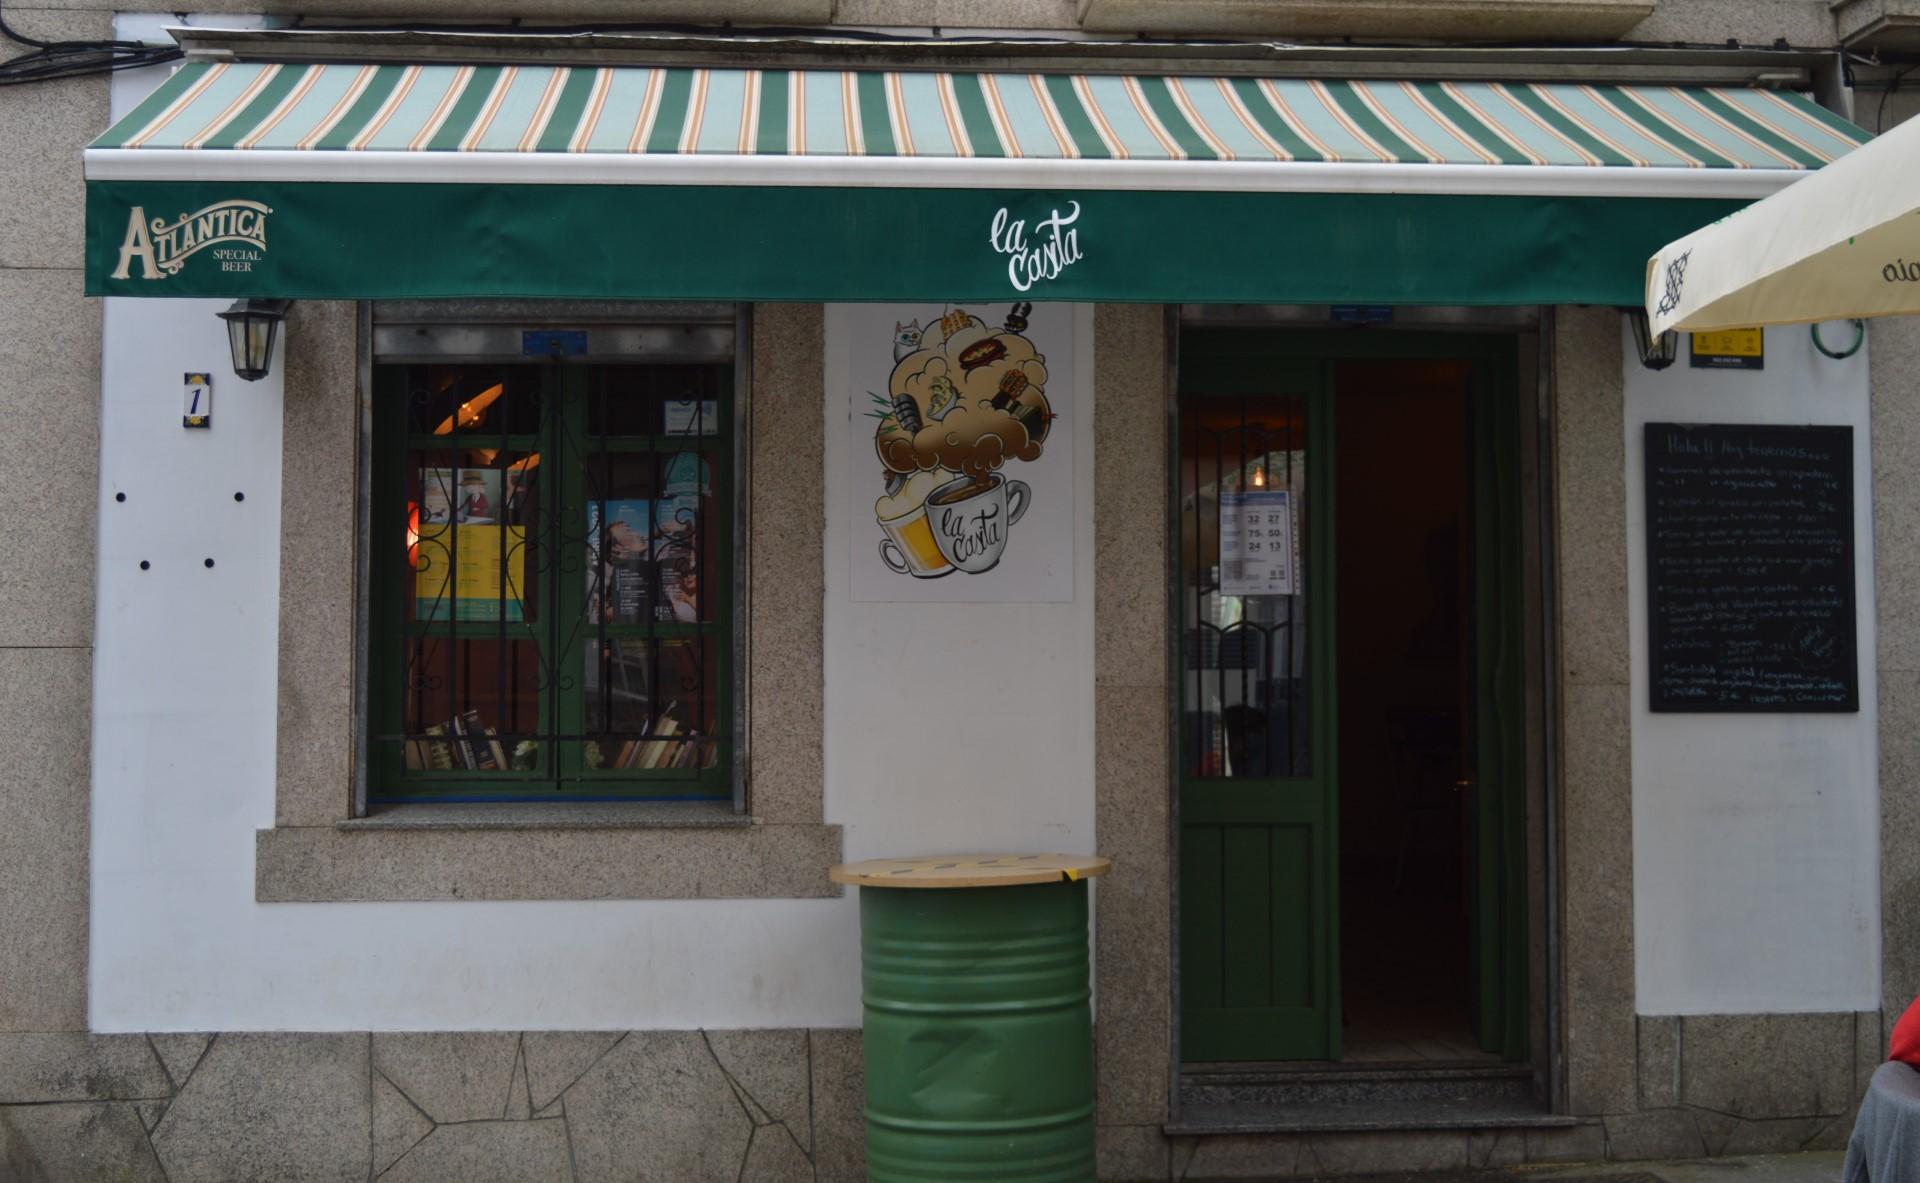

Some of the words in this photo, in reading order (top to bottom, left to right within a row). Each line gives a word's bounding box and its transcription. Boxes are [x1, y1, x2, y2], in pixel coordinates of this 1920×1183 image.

[989, 207, 1027, 253] la
[213, 249, 262, 261] SPECIAL
[222, 262, 252, 272] BEER
[190, 388, 202, 414] 1
[942, 507, 966, 537] la
